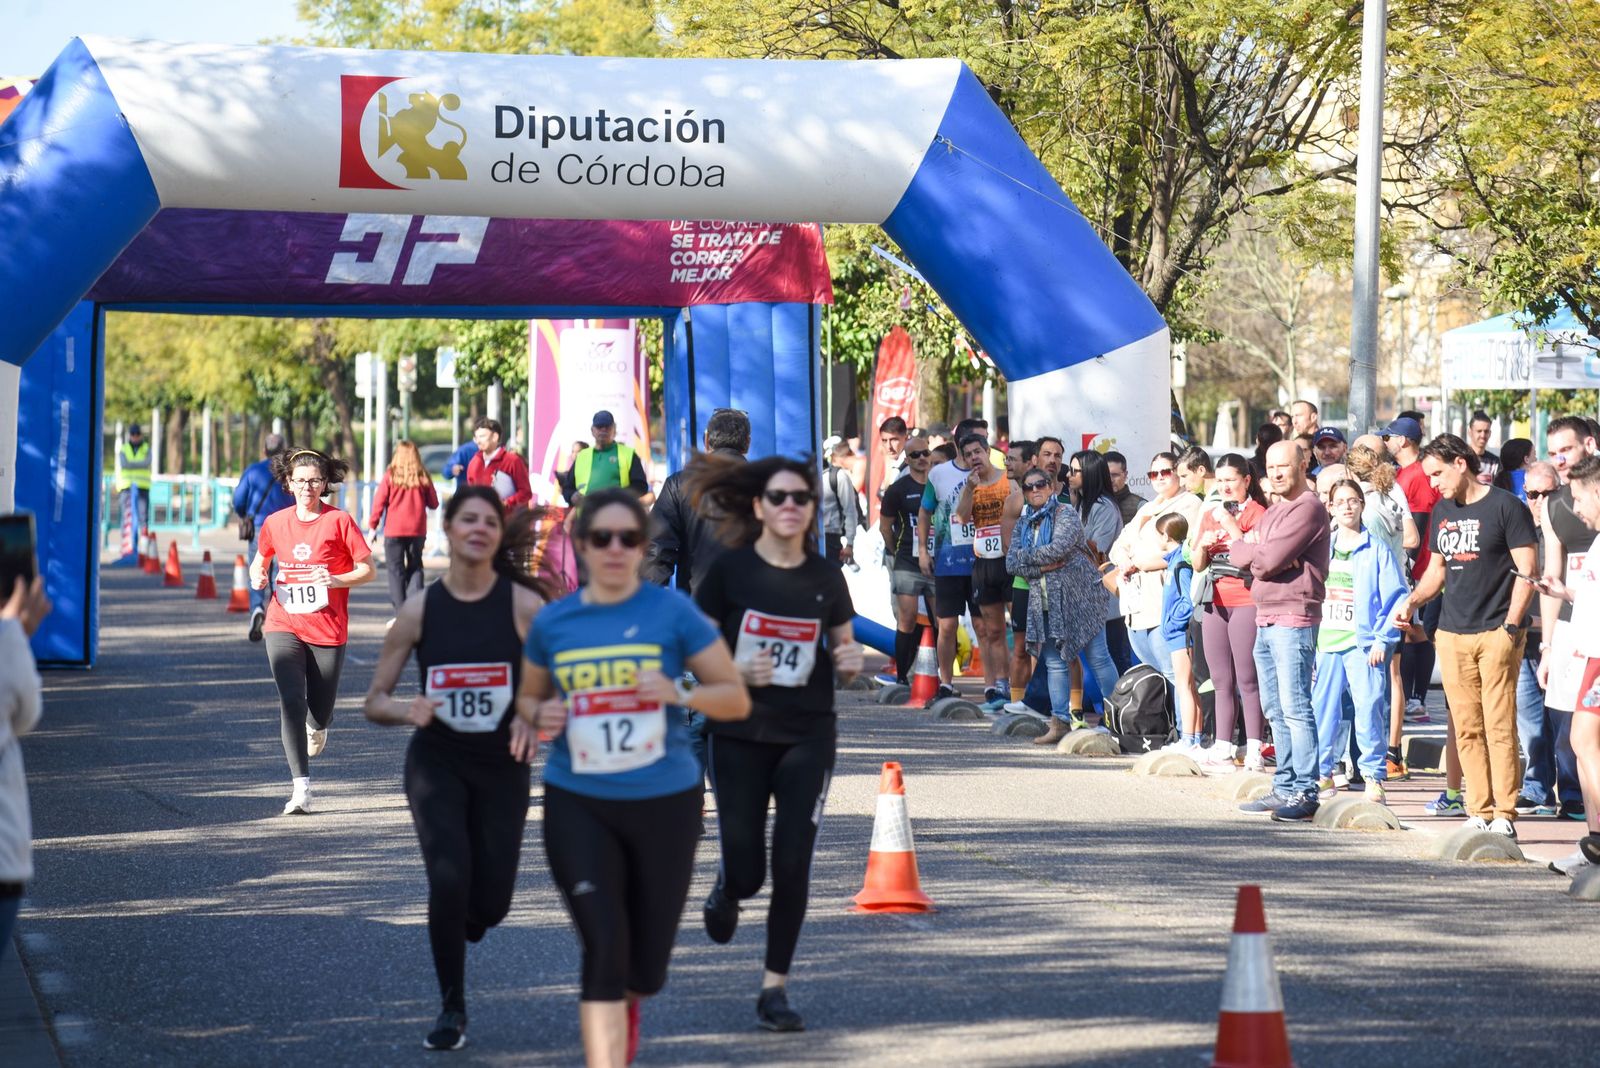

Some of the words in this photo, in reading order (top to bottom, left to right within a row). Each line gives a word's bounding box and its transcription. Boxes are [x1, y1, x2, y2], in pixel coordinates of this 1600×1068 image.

[495, 105, 725, 148] Diputación
[491, 153, 540, 183] de
[557, 154, 725, 187] Córdoba
[670, 233, 694, 248] SE
[698, 231, 754, 248] TRATA
[757, 230, 783, 245] DE
[670, 249, 744, 265] CORRER
[670, 266, 733, 283] MEJOR
[961, 525, 975, 538] 95
[985, 537, 1000, 552] 82
[287, 585, 316, 604] 119
[1328, 604, 1354, 621] 155
[756, 641, 800, 672] 84
[445, 690, 493, 718] 185
[600, 717, 635, 753] 12
